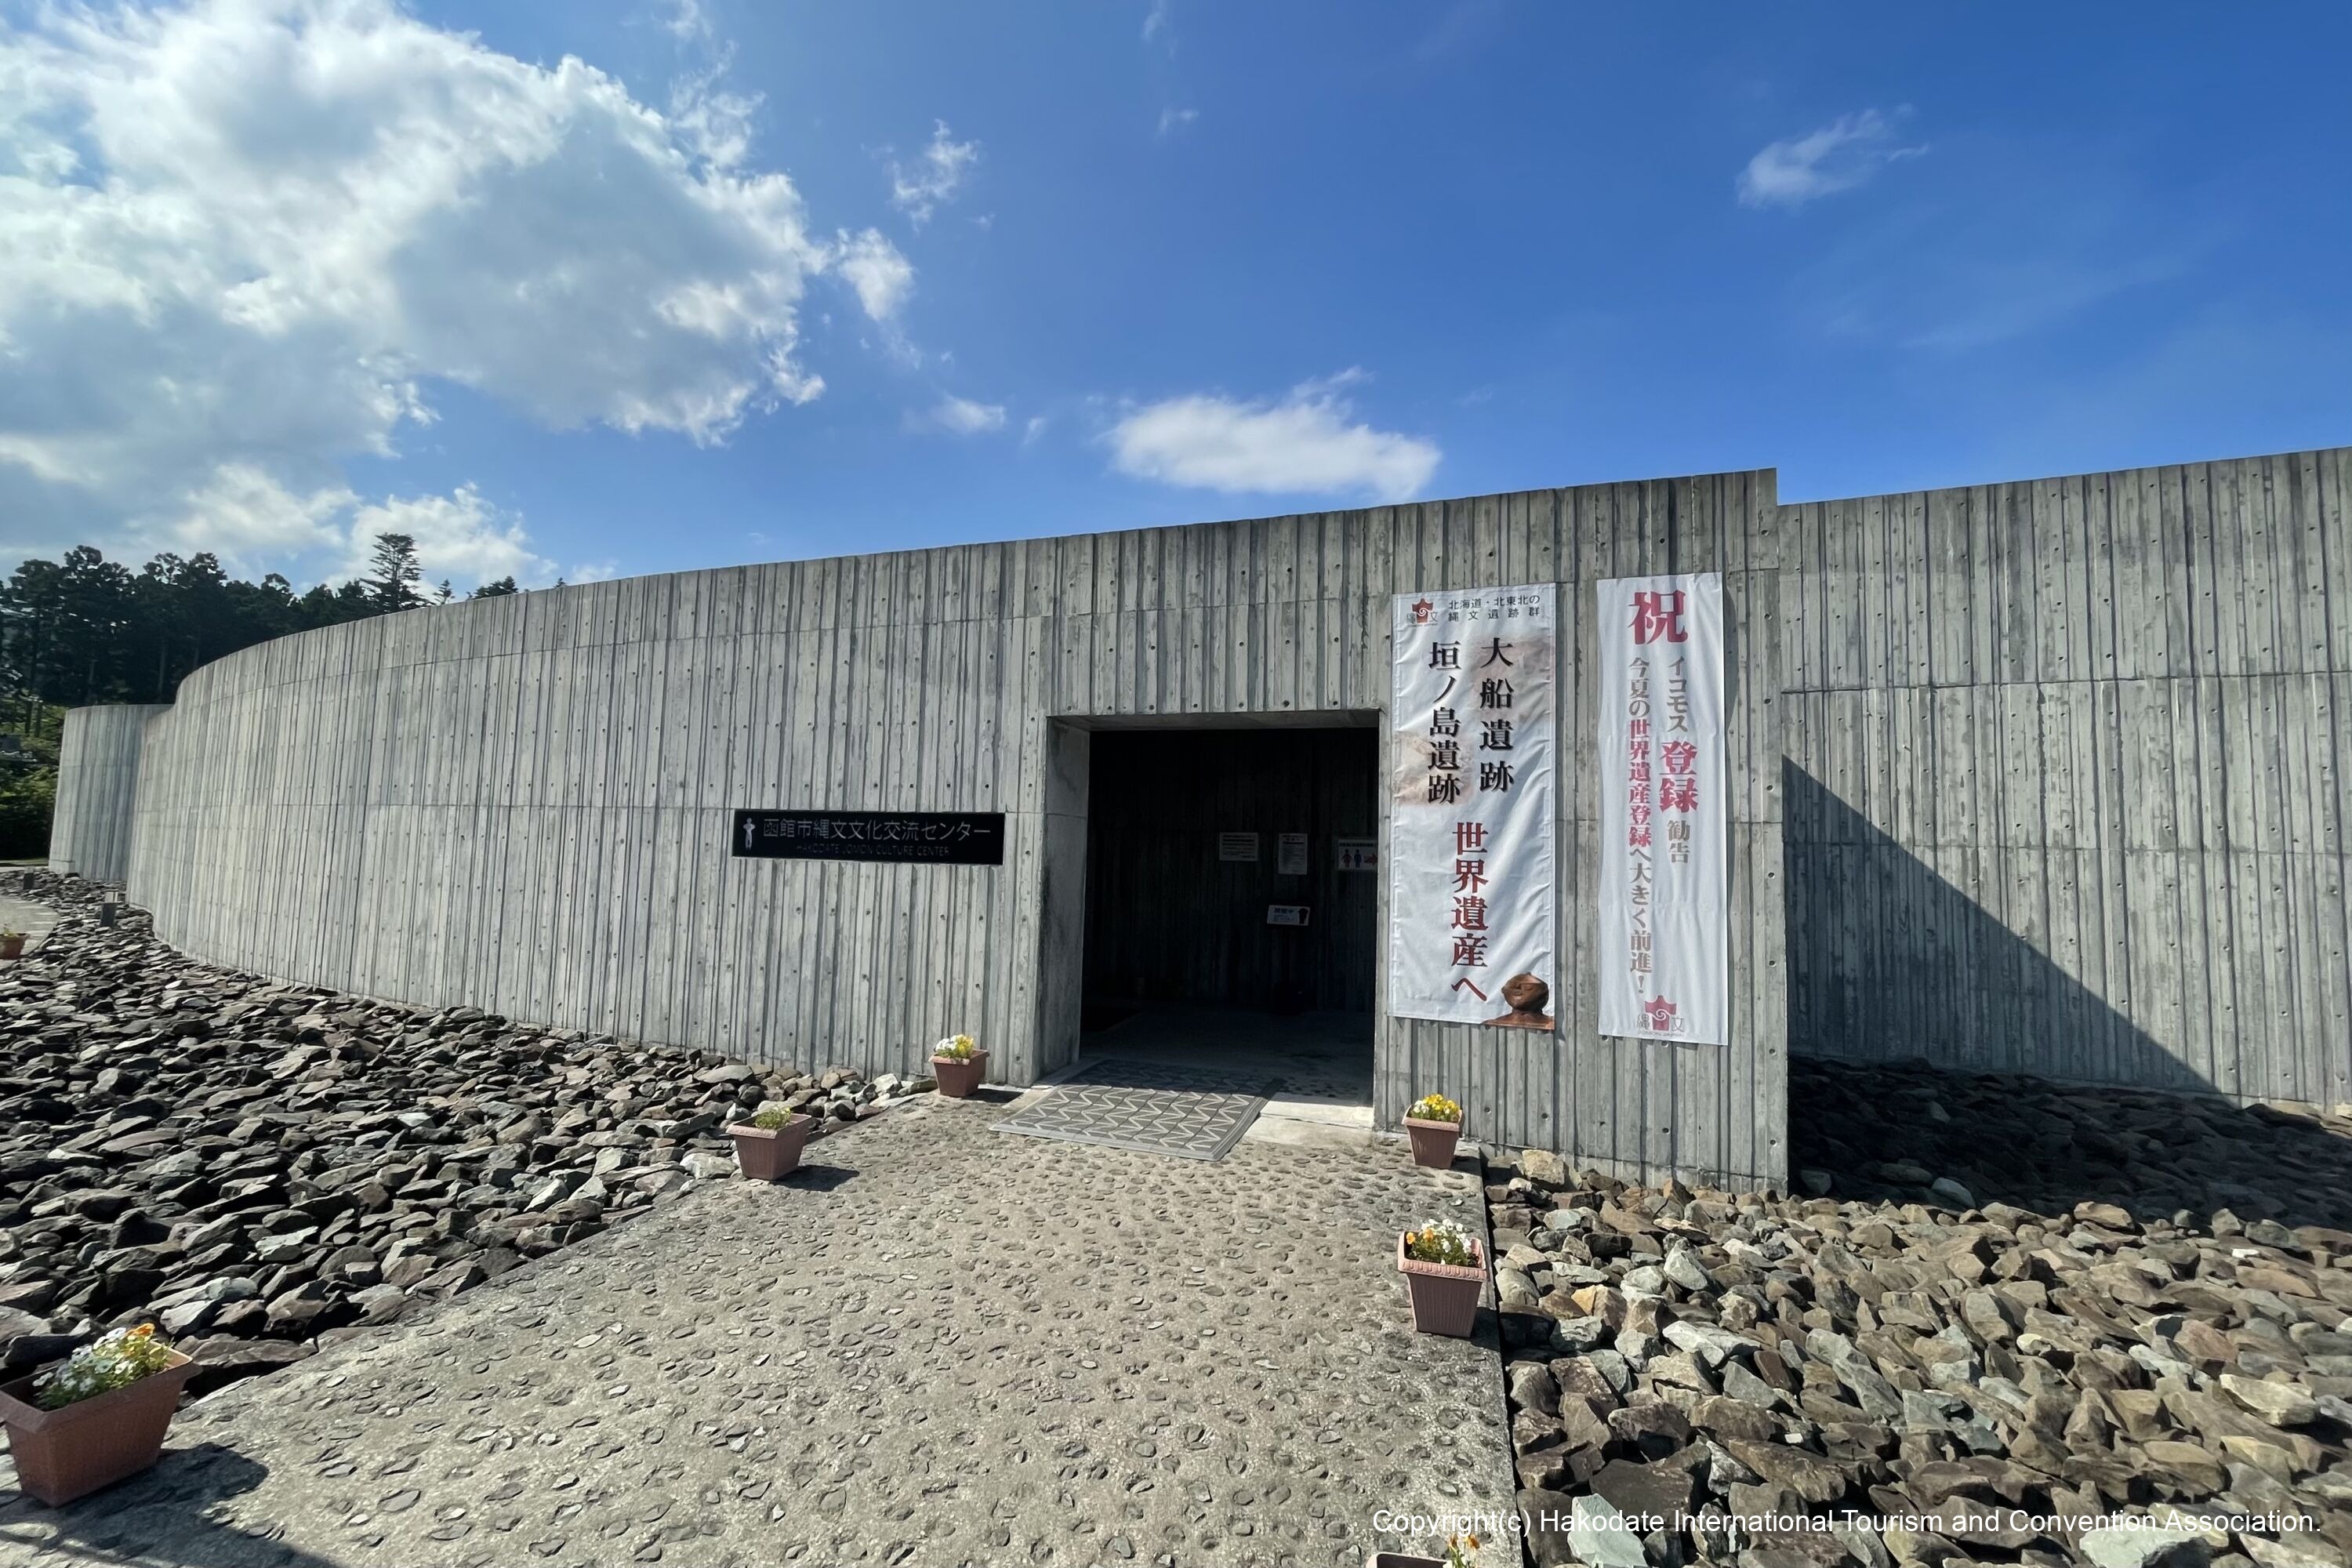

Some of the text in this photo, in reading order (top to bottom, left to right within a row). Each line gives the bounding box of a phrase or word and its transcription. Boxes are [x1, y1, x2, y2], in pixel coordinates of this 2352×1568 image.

[1448, 595, 1541, 610] 北海道・北東北の
[1448, 606, 1541, 622] 縄文遺跡群
[1628, 590, 1688, 644] 祝
[1428, 641, 1461, 804] 垣ノ島遺跡
[1479, 637, 1515, 793] 大船遺跡
[763, 818, 991, 841] 函館市縄文文化交流センター
[876, 844, 914, 856] CULTURE
[916, 845, 950, 857] CENTER
[1451, 822, 1489, 1002] 世界遺産へ
